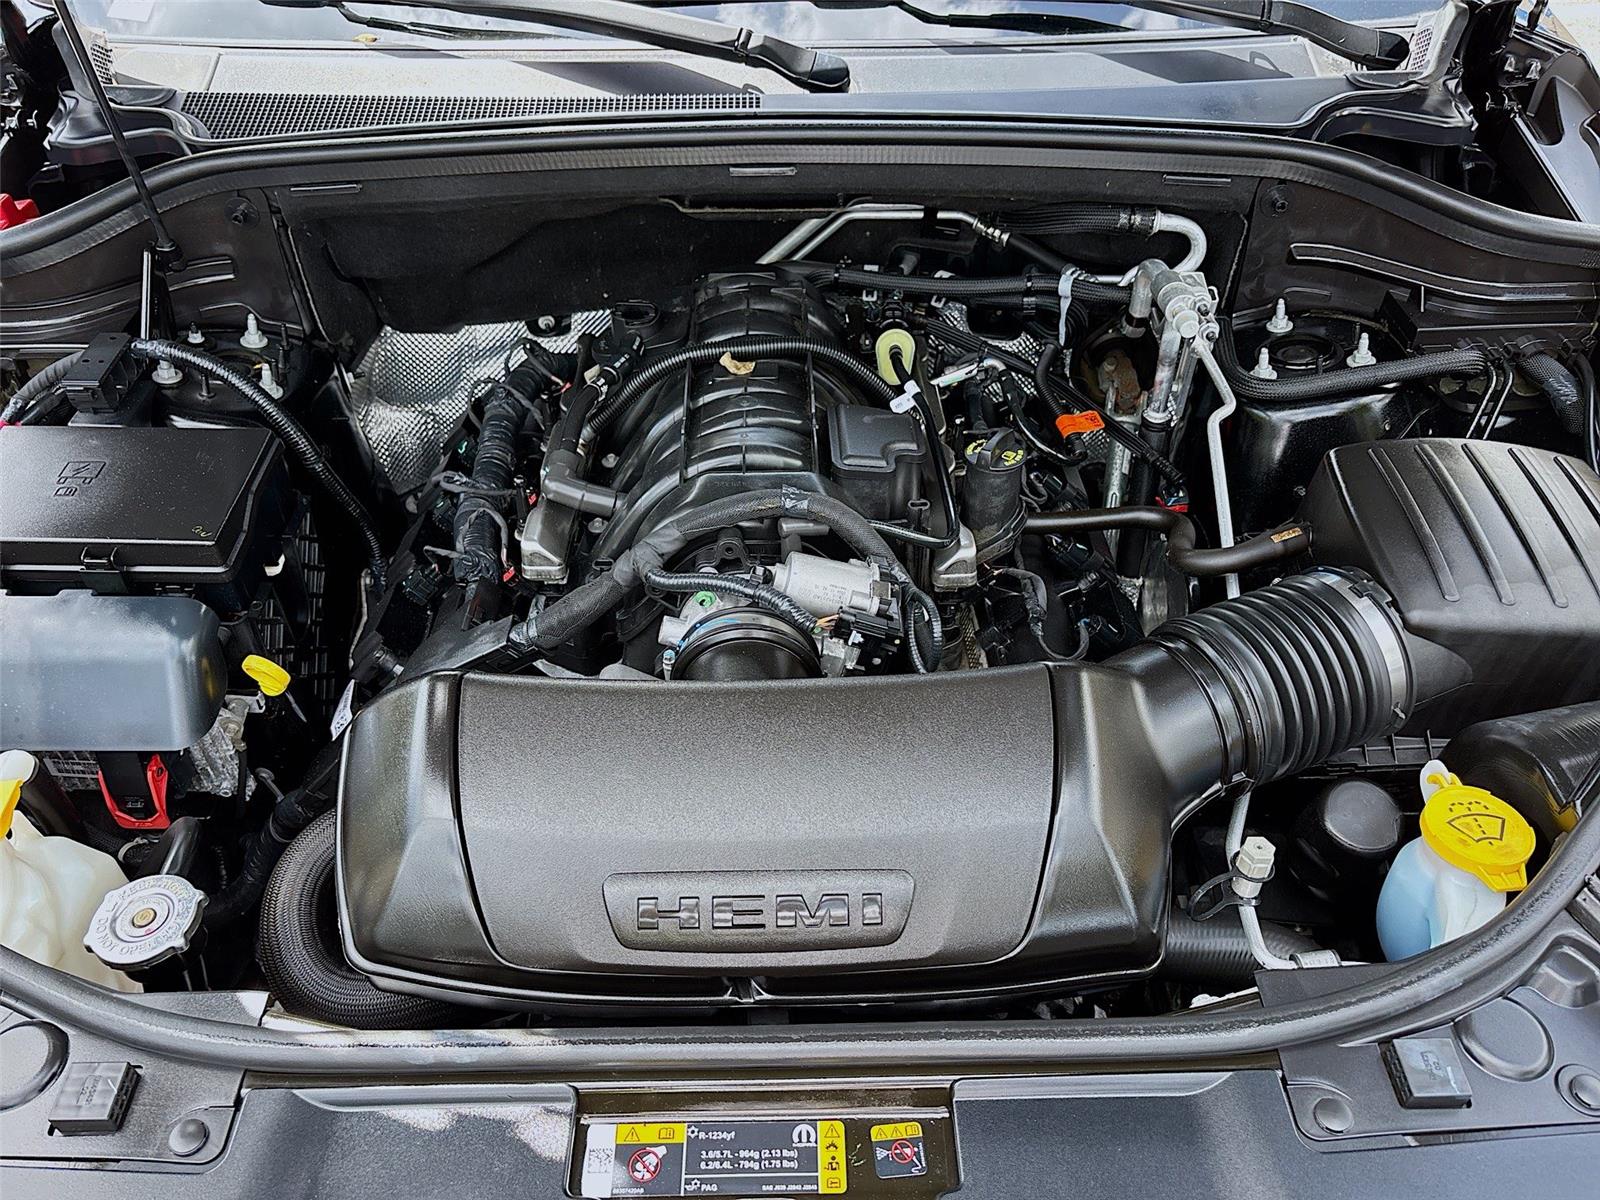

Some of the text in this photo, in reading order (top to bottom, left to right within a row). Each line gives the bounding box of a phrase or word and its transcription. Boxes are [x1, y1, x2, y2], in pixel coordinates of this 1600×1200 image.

[636, 892, 883, 931] HEMI
[698, 1131, 736, 1141] R-1234yf
[761, 1148, 781, 1159] (2.13
[782, 1148, 798, 1159] lbs)
[761, 1159, 781, 1170] (1.75
[782, 1159, 798, 1170] lbs)
[700, 1183, 718, 1192] PAG
